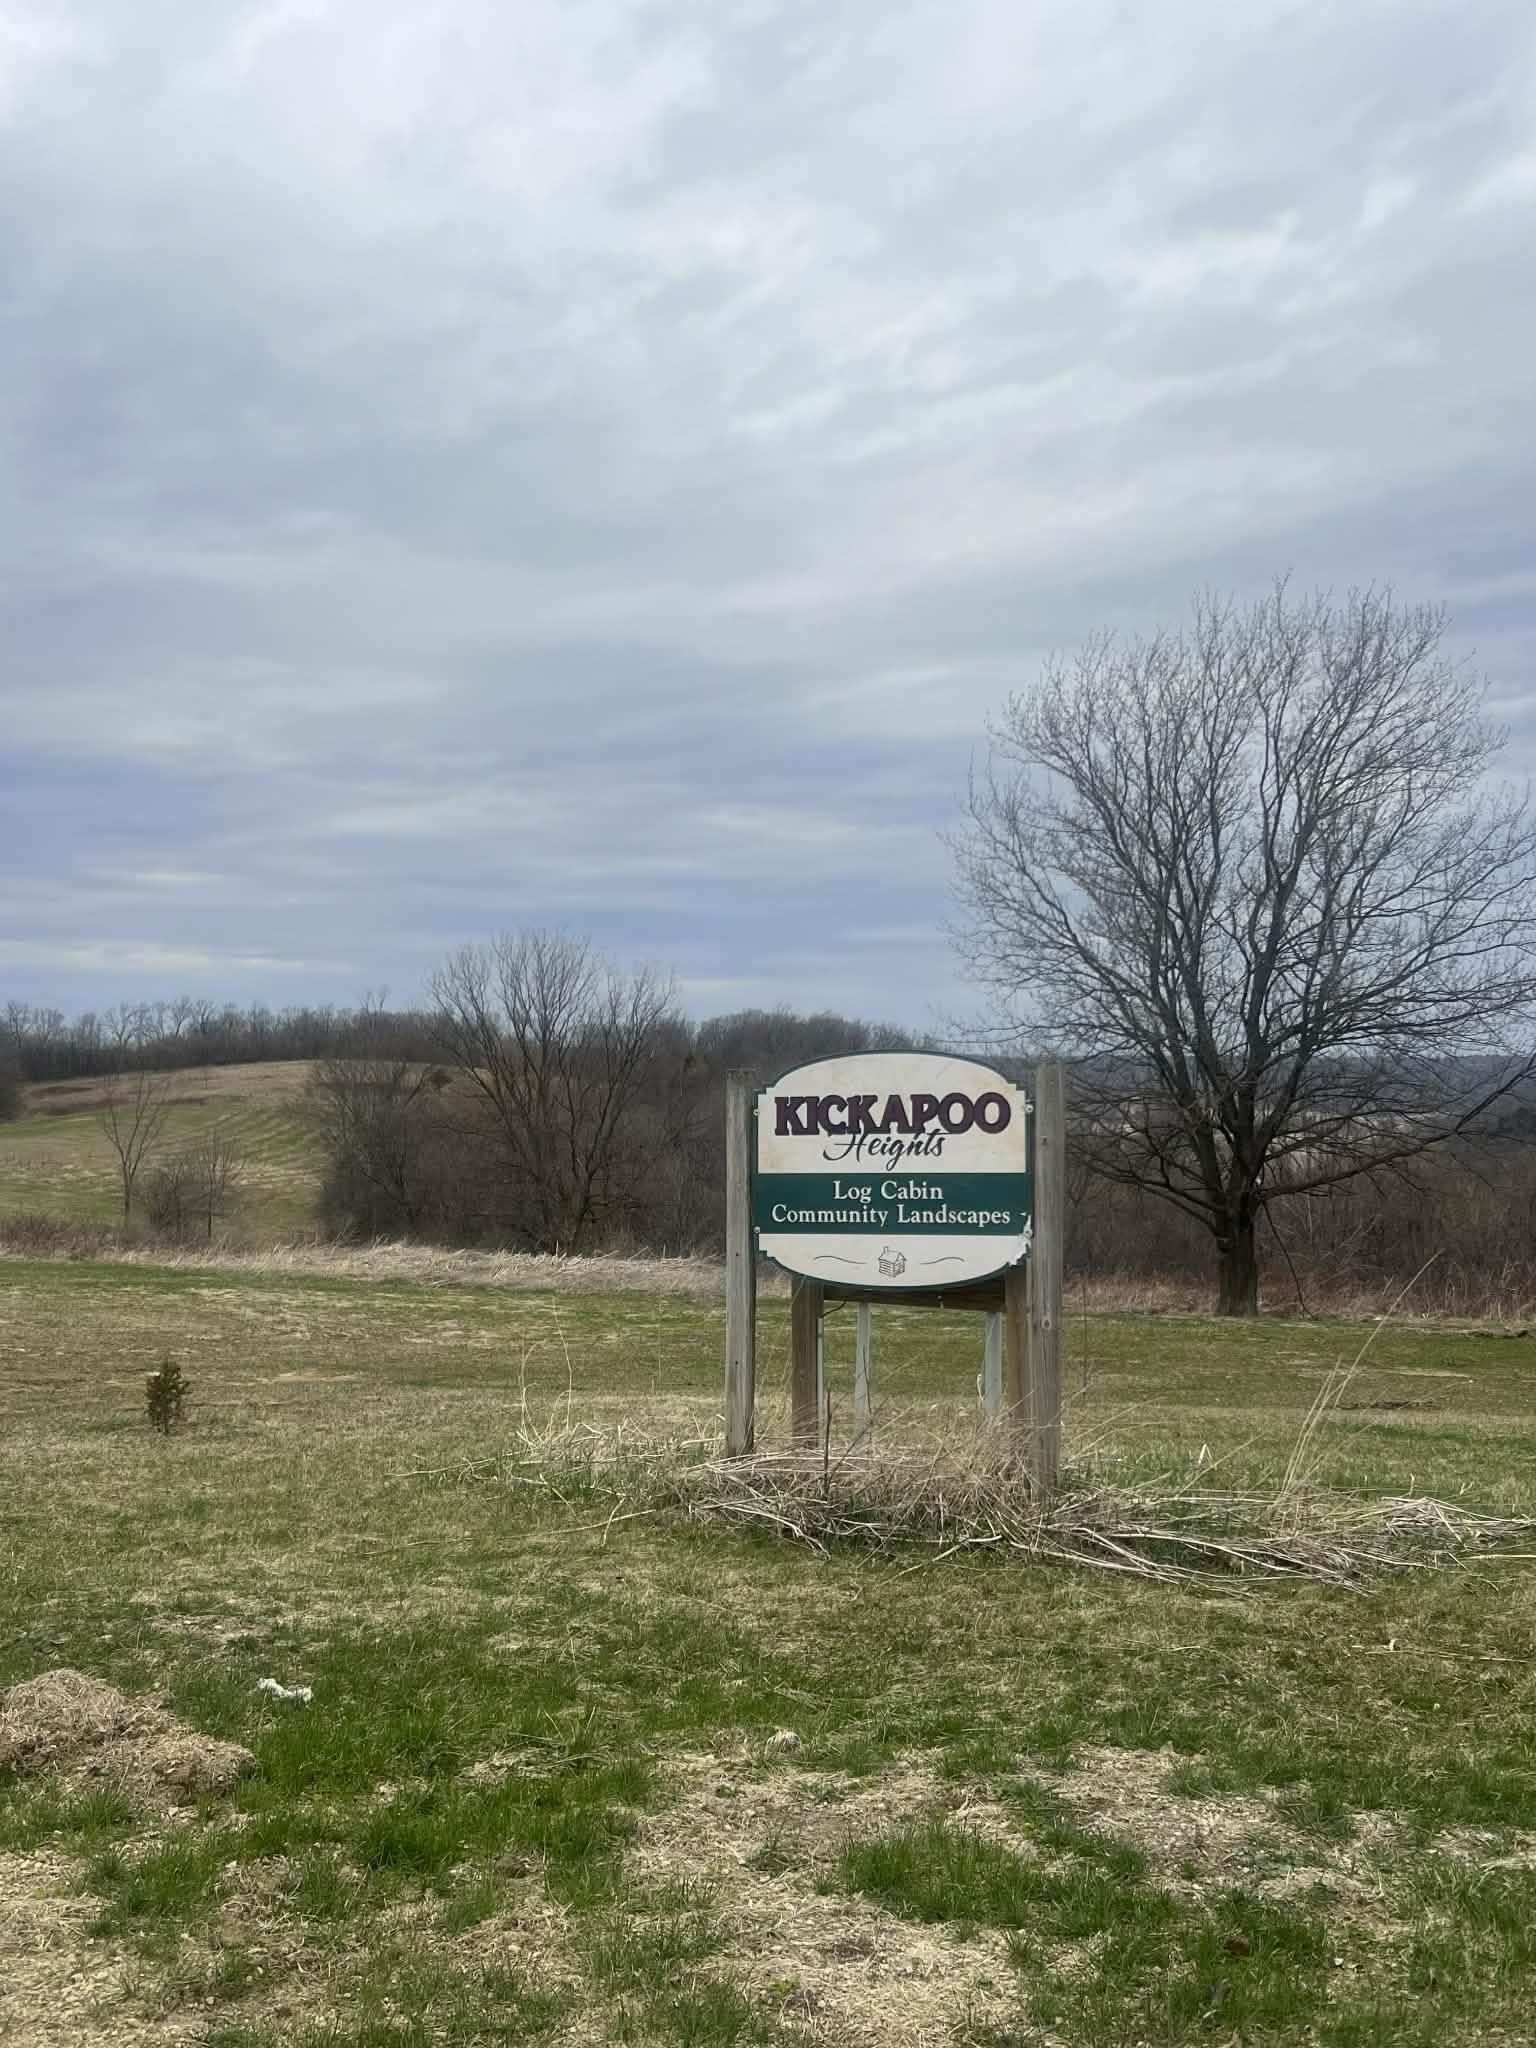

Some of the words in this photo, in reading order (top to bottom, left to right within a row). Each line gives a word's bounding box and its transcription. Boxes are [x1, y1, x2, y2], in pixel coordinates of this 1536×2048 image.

[774, 1092, 1012, 1136] KICKAPOO
[822, 1128, 947, 1172] Heights
[833, 1180, 872, 1202] Log
[880, 1180, 944, 1200] Cabin
[771, 1204, 889, 1227] Community
[896, 1205, 1011, 1227] Landscapes
